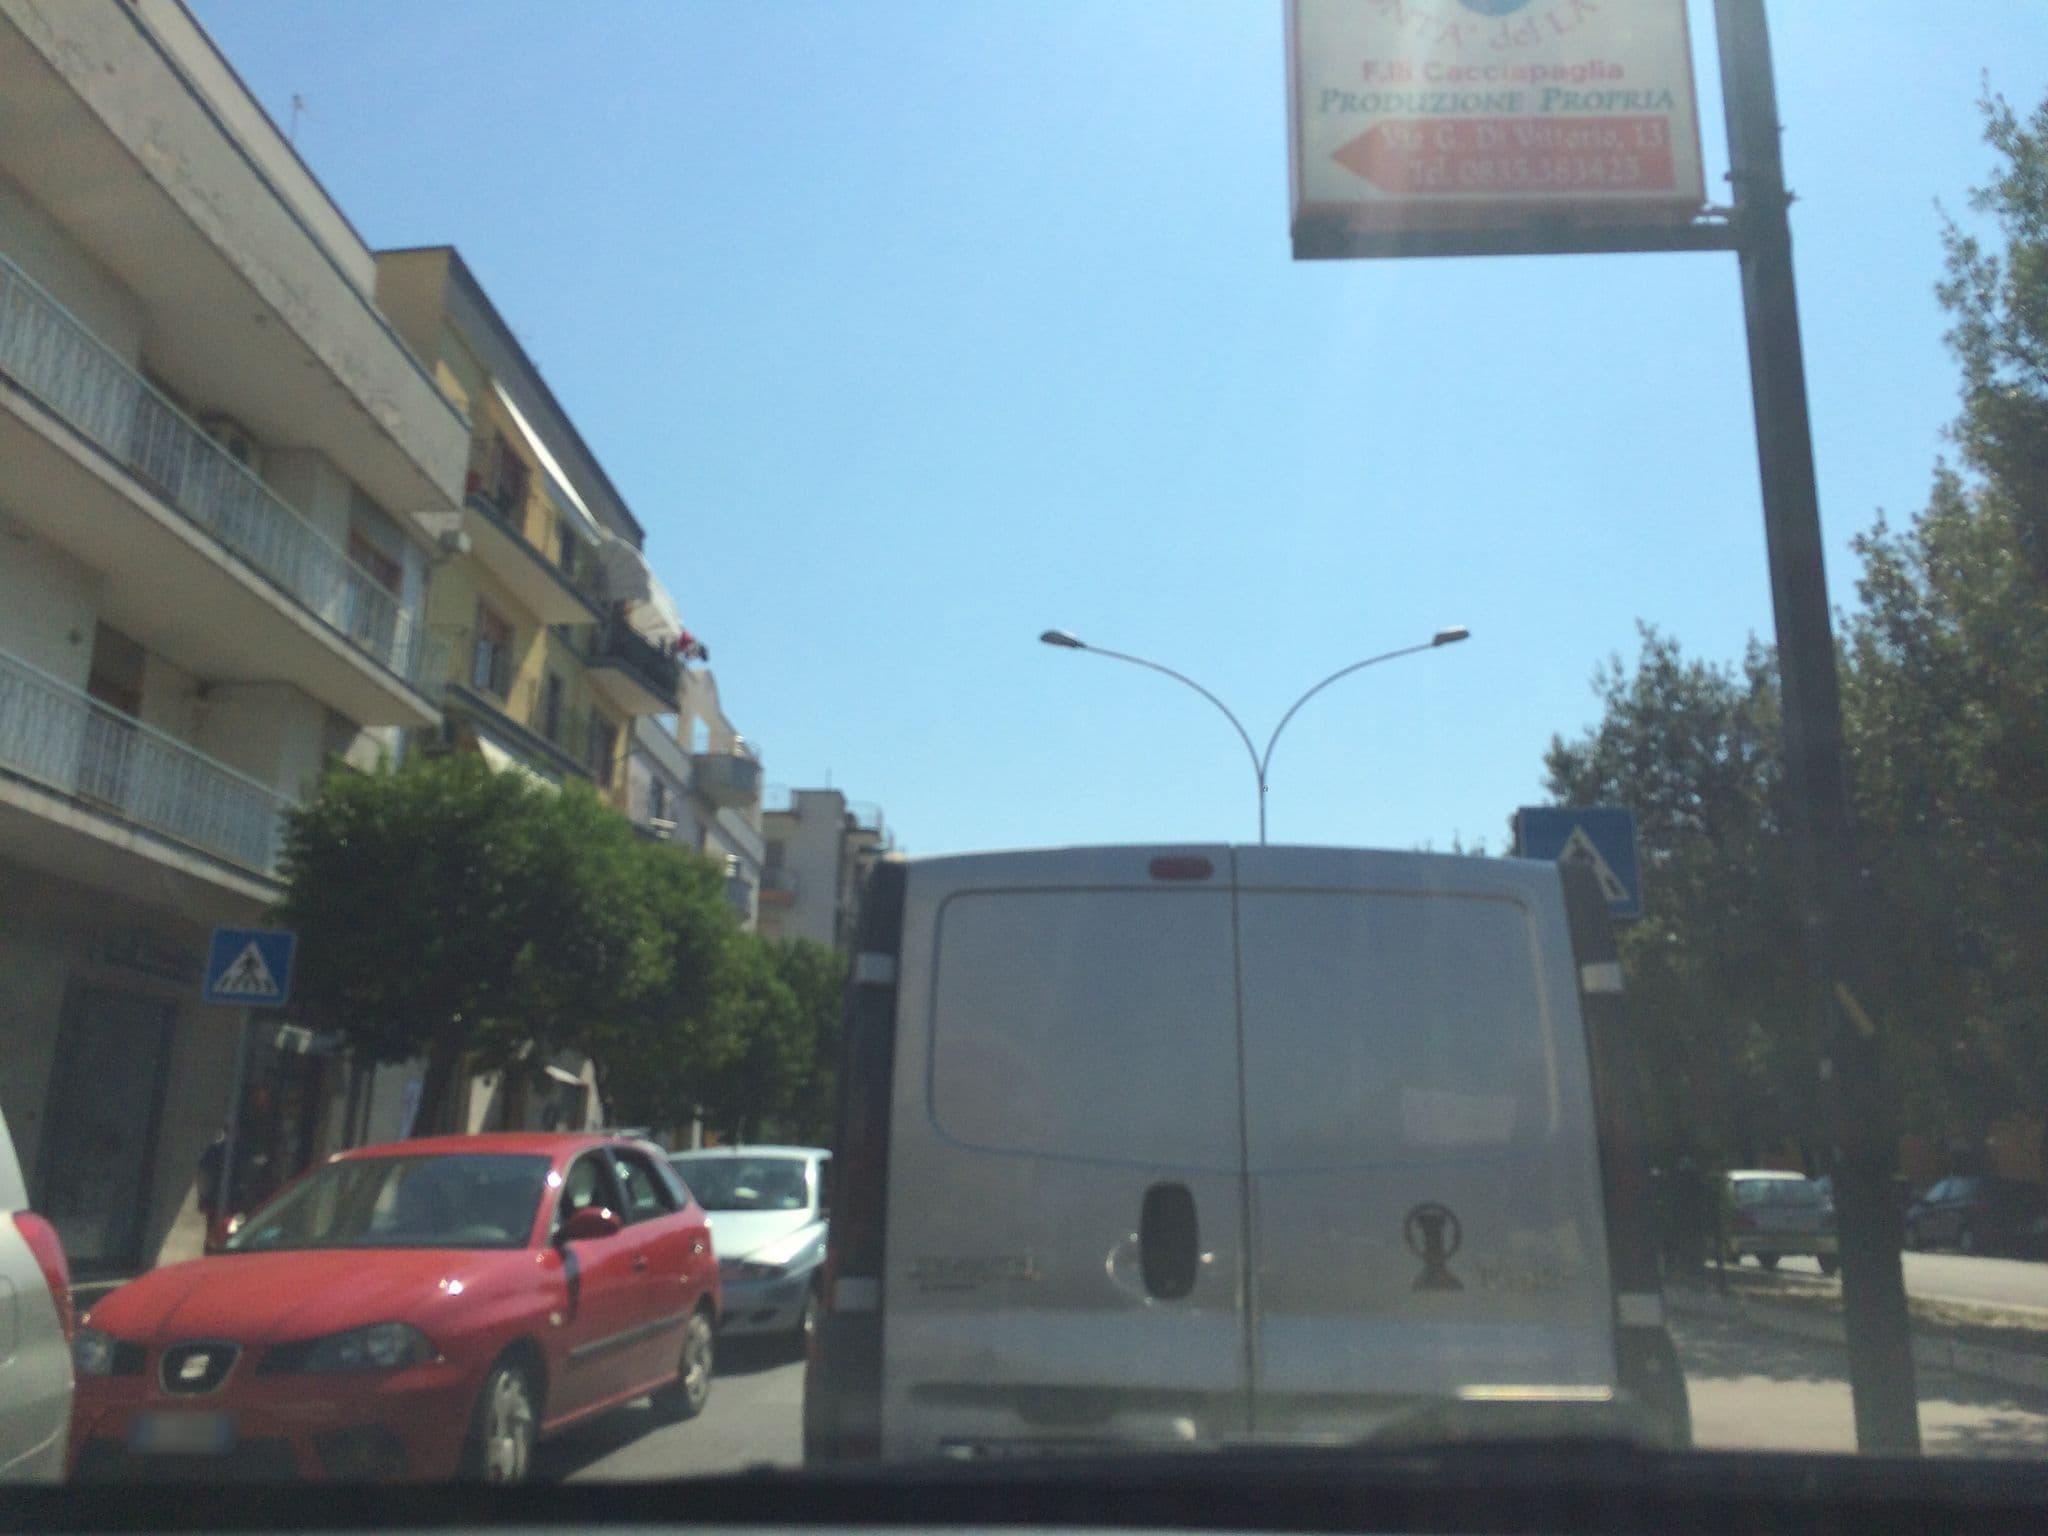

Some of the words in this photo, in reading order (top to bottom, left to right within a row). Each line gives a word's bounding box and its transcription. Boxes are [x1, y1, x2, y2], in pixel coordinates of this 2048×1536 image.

[1424, 60, 1625, 84] Cacciapaglia
[1319, 88, 1524, 114] PRODUZIONE
[1541, 87, 1675, 113] PROPRIA
